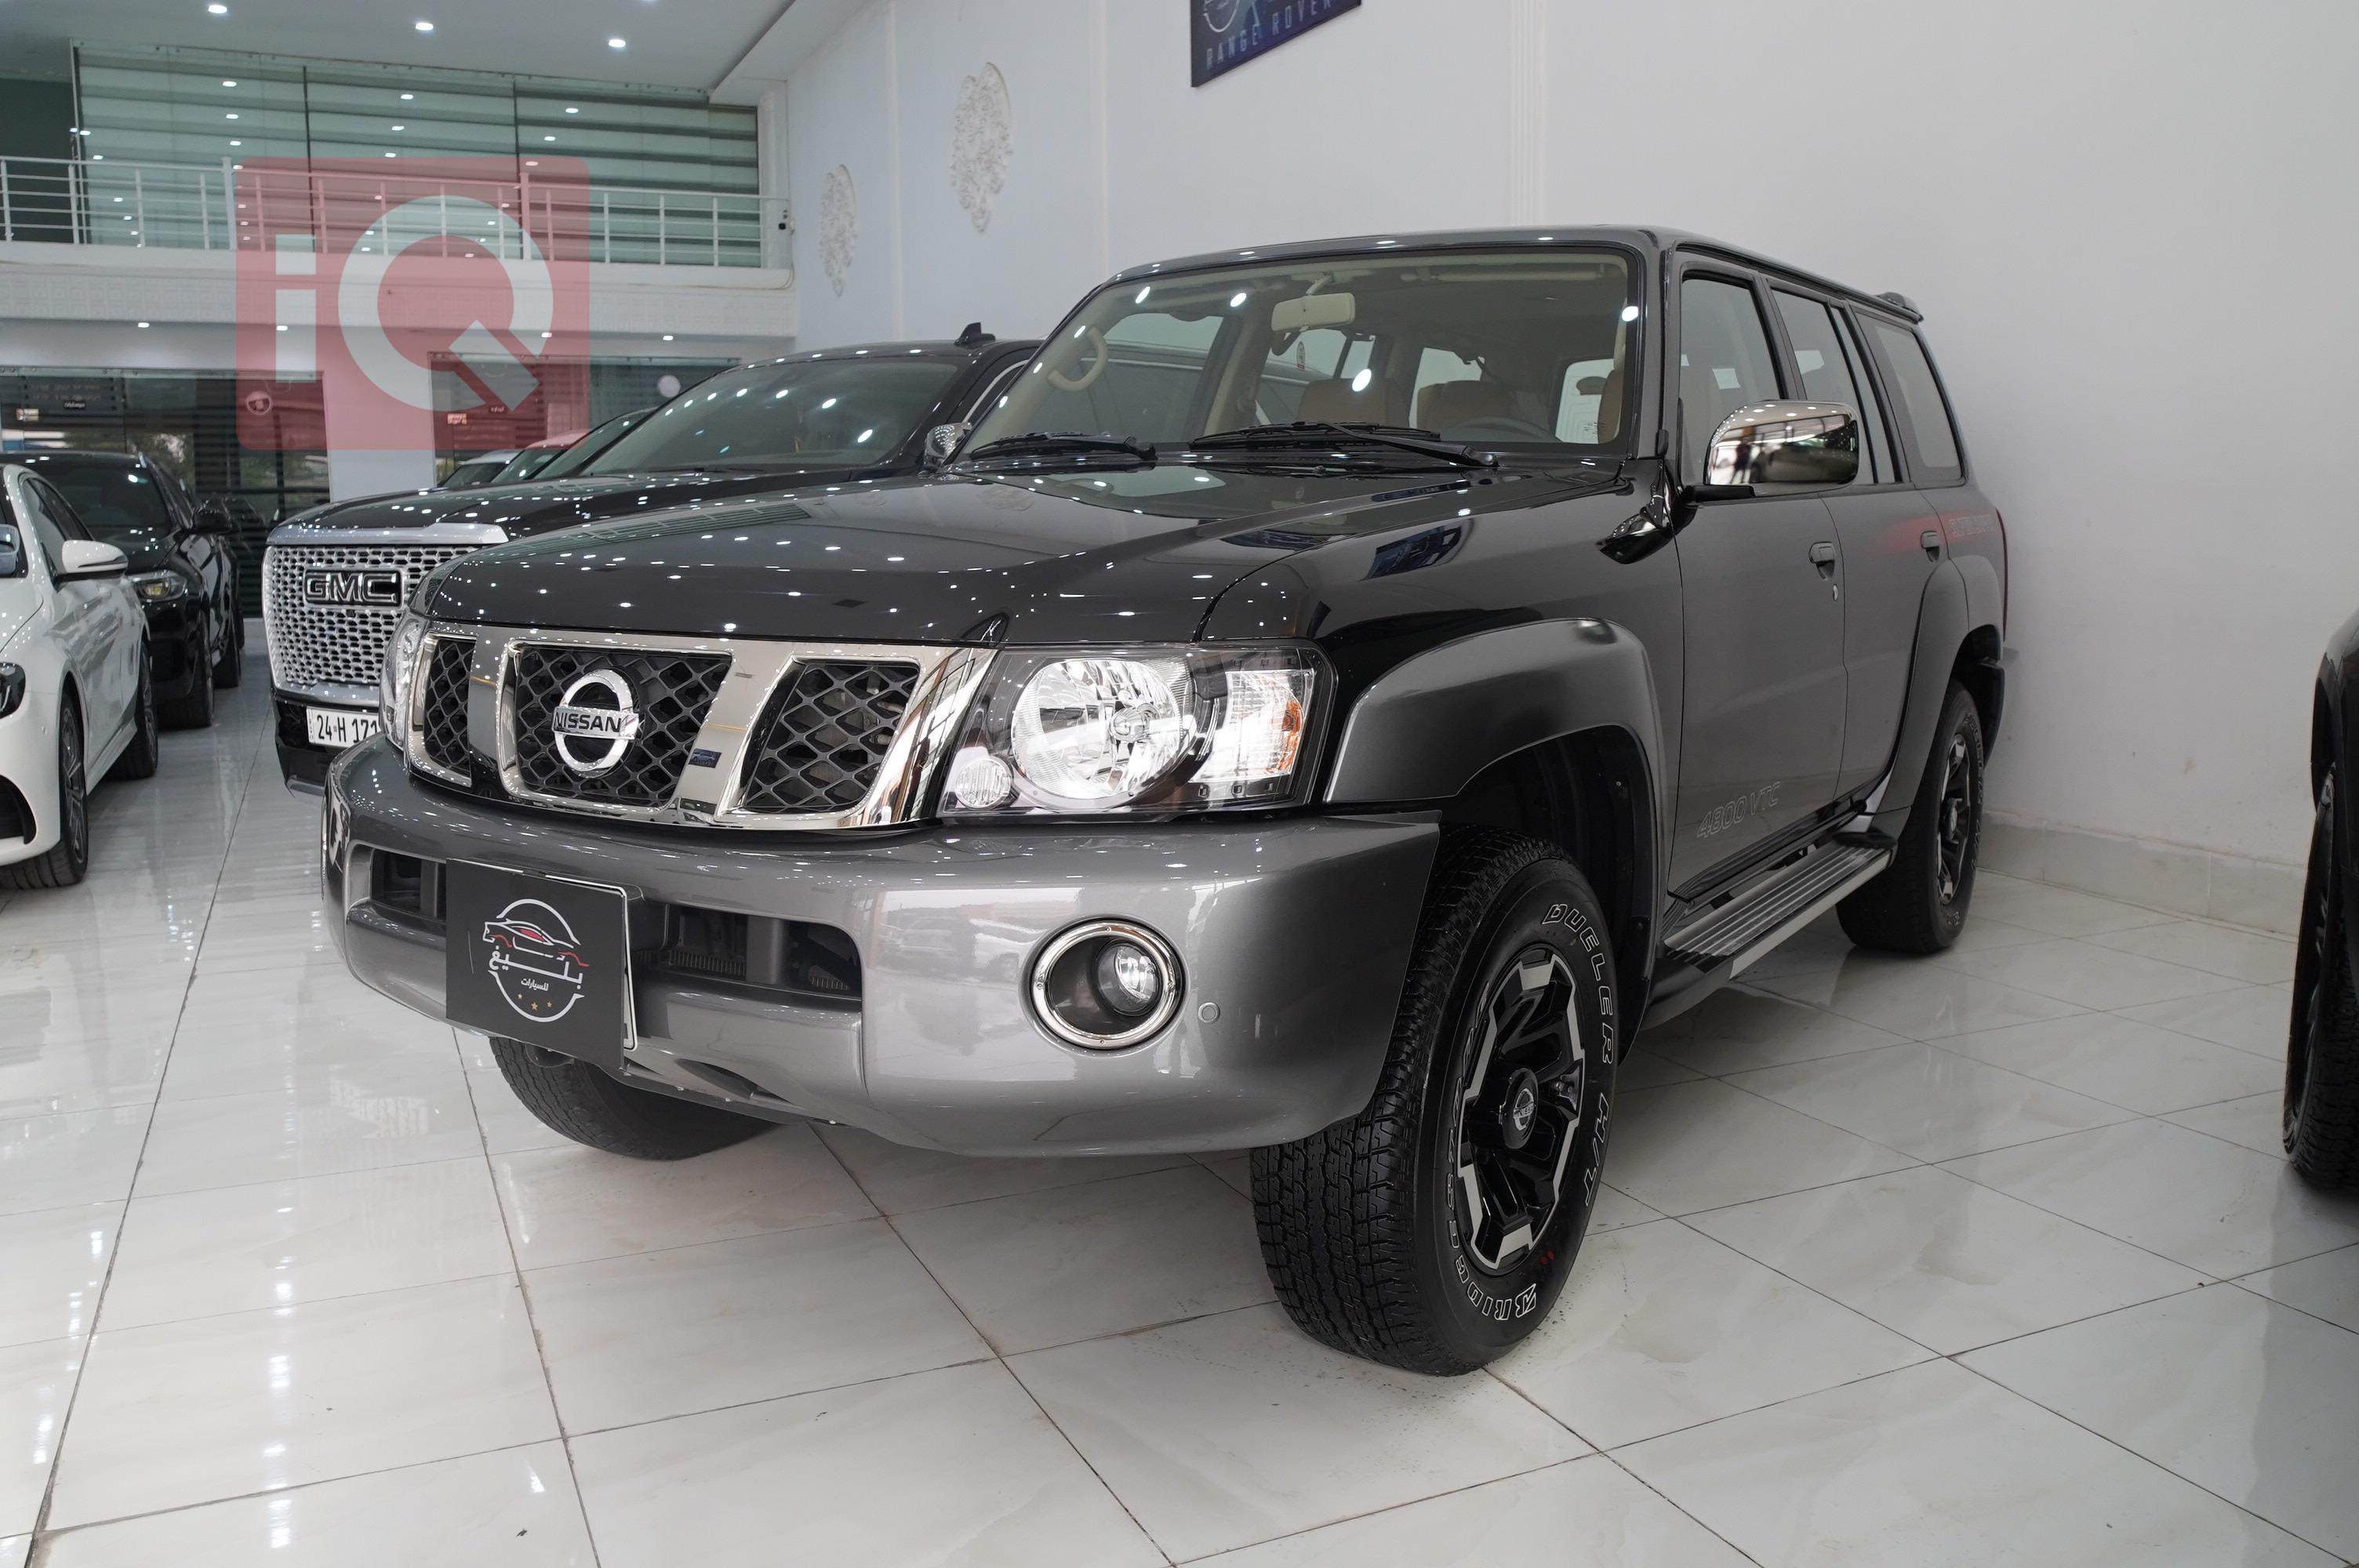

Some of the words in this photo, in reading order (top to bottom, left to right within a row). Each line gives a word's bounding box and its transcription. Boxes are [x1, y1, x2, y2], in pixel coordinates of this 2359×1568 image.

[1206, 24, 1258, 70] RANGE
[305, 572, 398, 604] GMC
[554, 711, 622, 733] NISSAN
[521, 978, 549, 992] للسيارات
[1542, 903, 1614, 1064] DUELER
